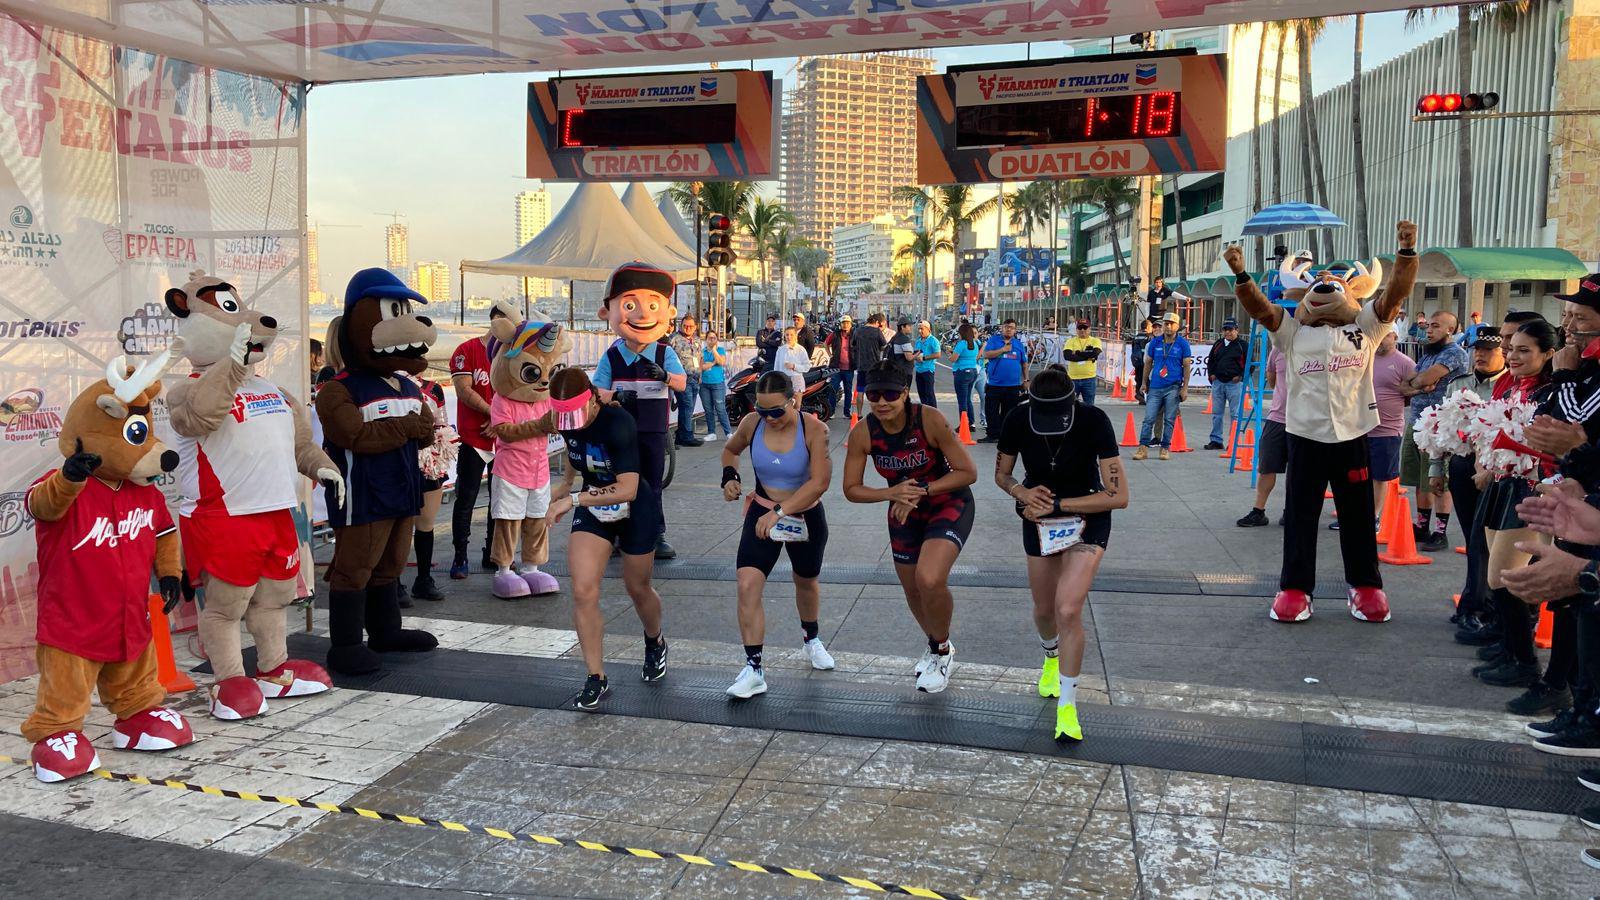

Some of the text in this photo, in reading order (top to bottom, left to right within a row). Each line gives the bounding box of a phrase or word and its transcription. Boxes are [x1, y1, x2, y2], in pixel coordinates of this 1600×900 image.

[1083, 85, 1130, 94] SKECHERS
[591, 150, 699, 175] TRIATLÓN
[1001, 147, 1132, 176] DUATLÓN
[144, 223, 175, 235] TACOS
[147, 305, 161, 317] LA
[11, 433, 33, 441] Queso
[875, 448, 929, 469] TRIMAZ
[775, 523, 802, 535] 542
[1048, 528, 1076, 541] 543
